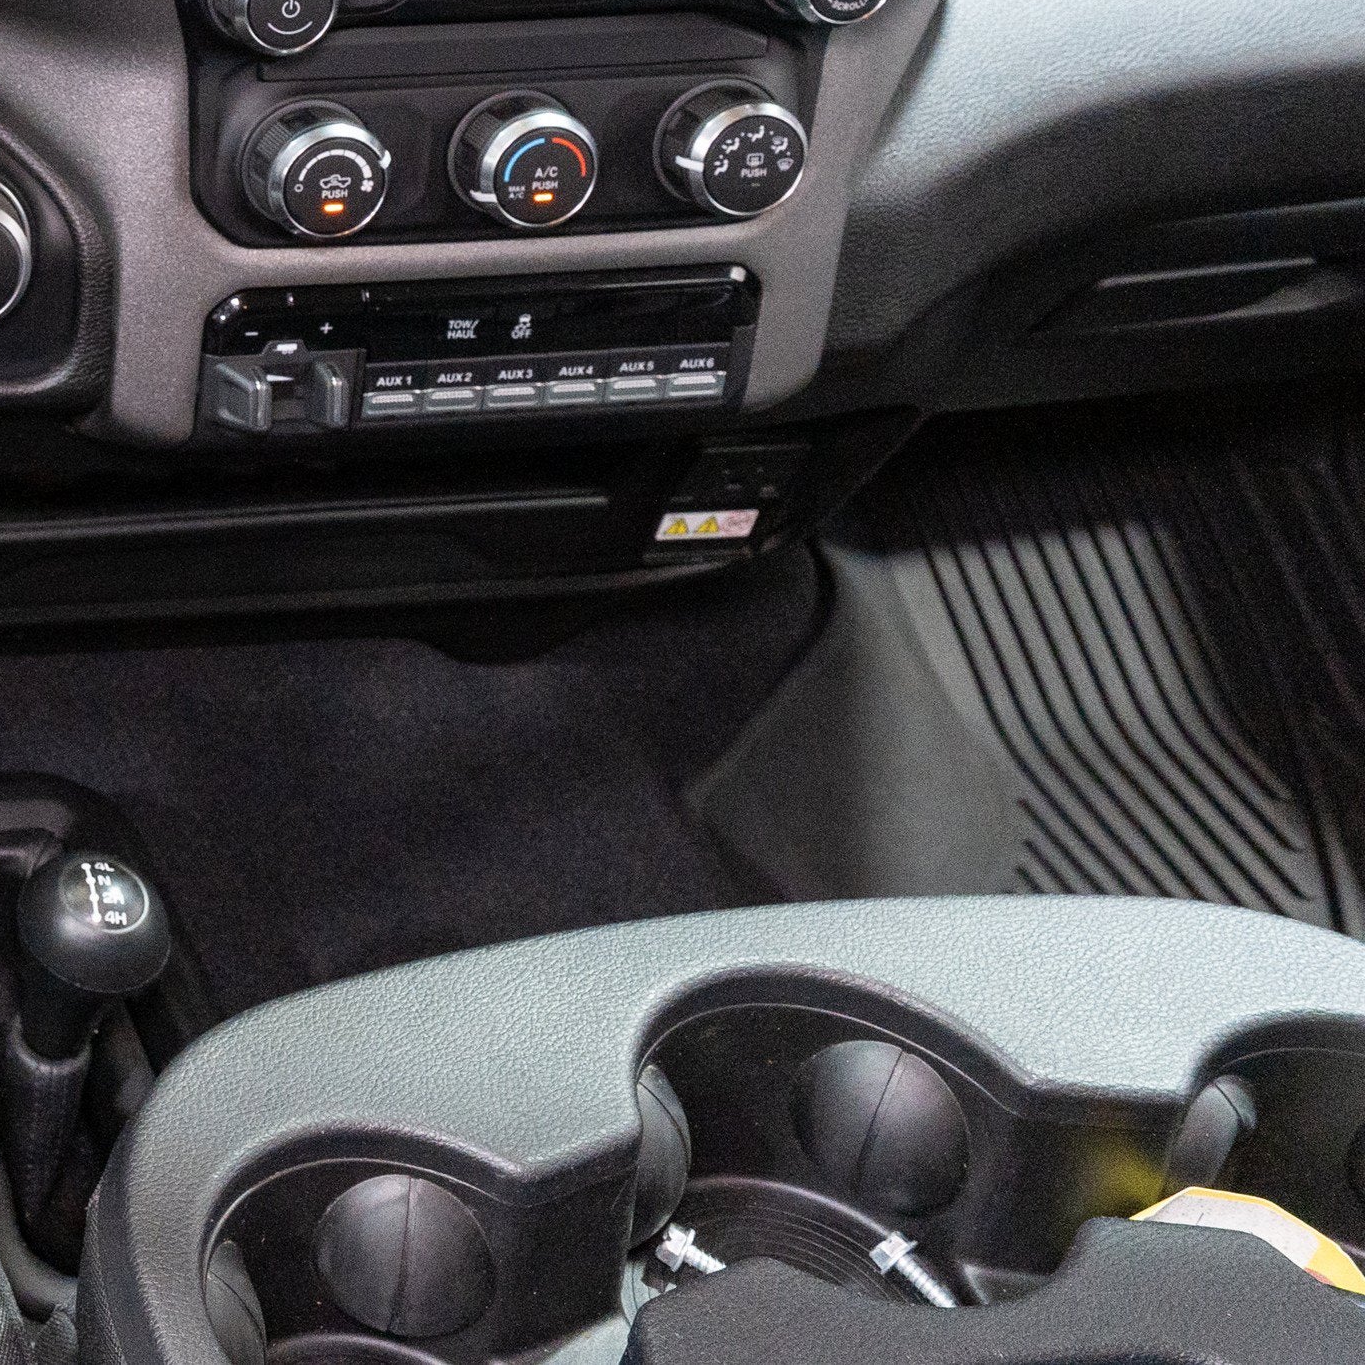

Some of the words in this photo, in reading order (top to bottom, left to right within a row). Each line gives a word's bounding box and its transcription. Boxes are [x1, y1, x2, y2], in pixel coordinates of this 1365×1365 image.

[534, 165, 558, 179] A/C
[740, 167, 768, 178] PUSH
[532, 180, 559, 191] PUSH
[322, 188, 349, 199] PUSH
[447, 329, 476, 340] HAUL
[511, 327, 532, 339] OFF
[620, 362, 645, 372] AUX
[646, 361, 654, 371] 5
[679, 359, 705, 369] AUX
[706, 357, 715, 367] 6
[498, 370, 524, 380] AUX
[525, 369, 533, 379] 3
[559, 367, 584, 376] AUX
[586, 366, 594, 375] 4
[376, 377, 402, 387] AUX
[405, 376, 412, 385] 1
[437, 374, 463, 383] AUX
[464, 372, 472, 382] 2
[94, 861, 115, 872] 4L
[97, 875, 112, 885] N
[104, 910, 127, 925] 4H
